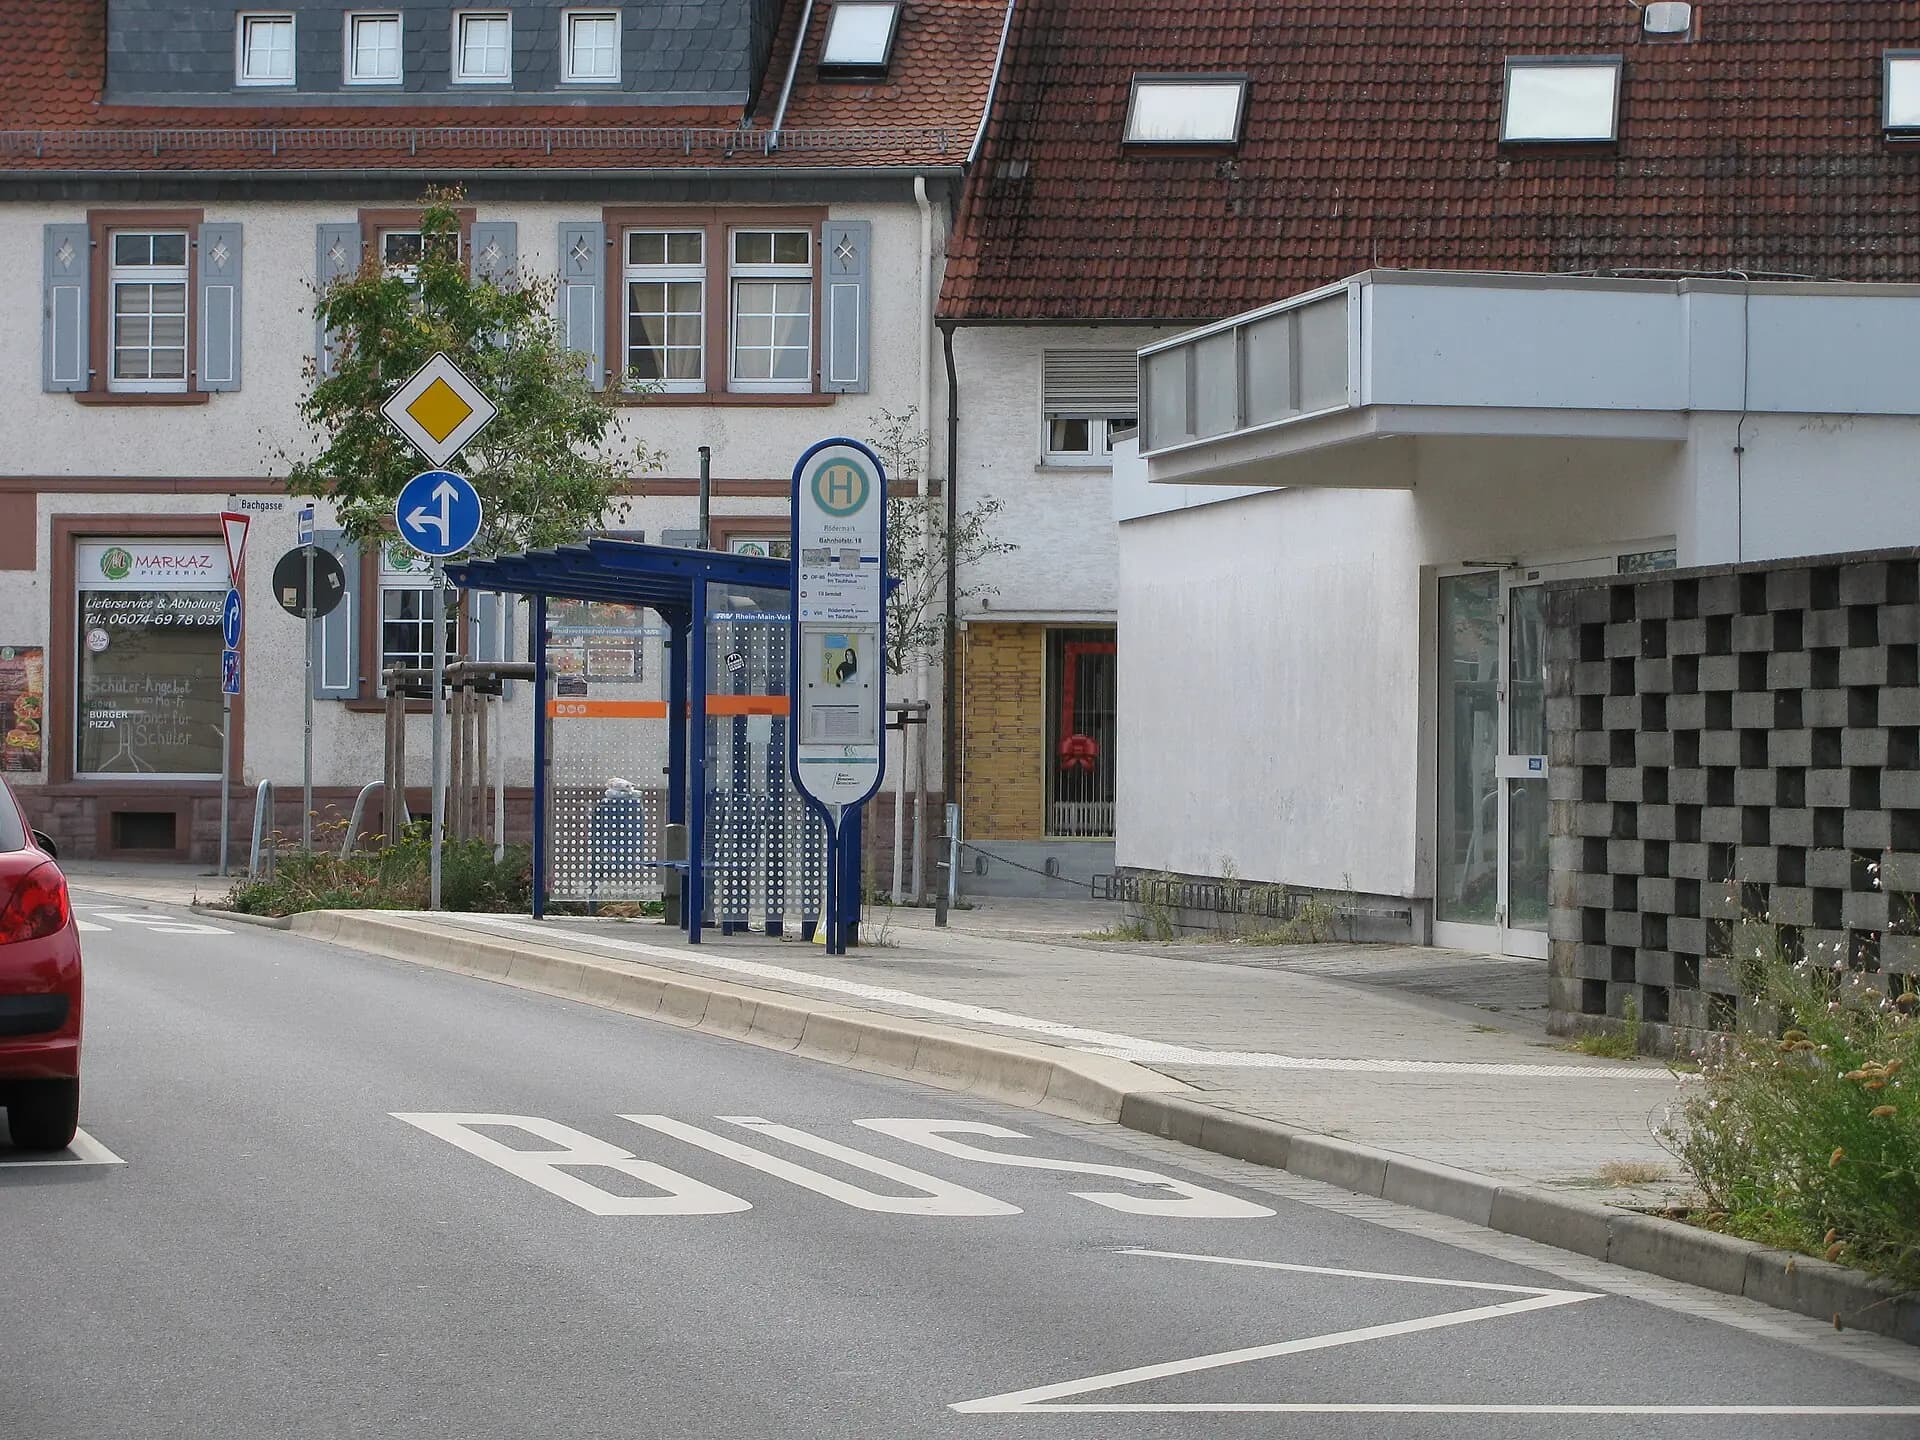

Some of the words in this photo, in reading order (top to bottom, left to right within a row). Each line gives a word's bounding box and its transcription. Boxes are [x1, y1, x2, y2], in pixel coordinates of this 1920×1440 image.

[829, 471, 852, 504] H
[241, 499, 283, 512] Bachgasse
[135, 555, 213, 569] MARKAZ
[85, 597, 154, 609] Lieferservice
[157, 599, 167, 609] &
[169, 598, 224, 612] Abholung
[84, 613, 106, 625] Tel.:
[109, 613, 173, 625] 06074-69
[176, 614, 194, 626] 78
[197, 614, 224, 626] 037
[89, 710, 129, 719] BURGER
[89, 720, 116, 729] PIZZA
[386, 1111, 1278, 1218] BUS
